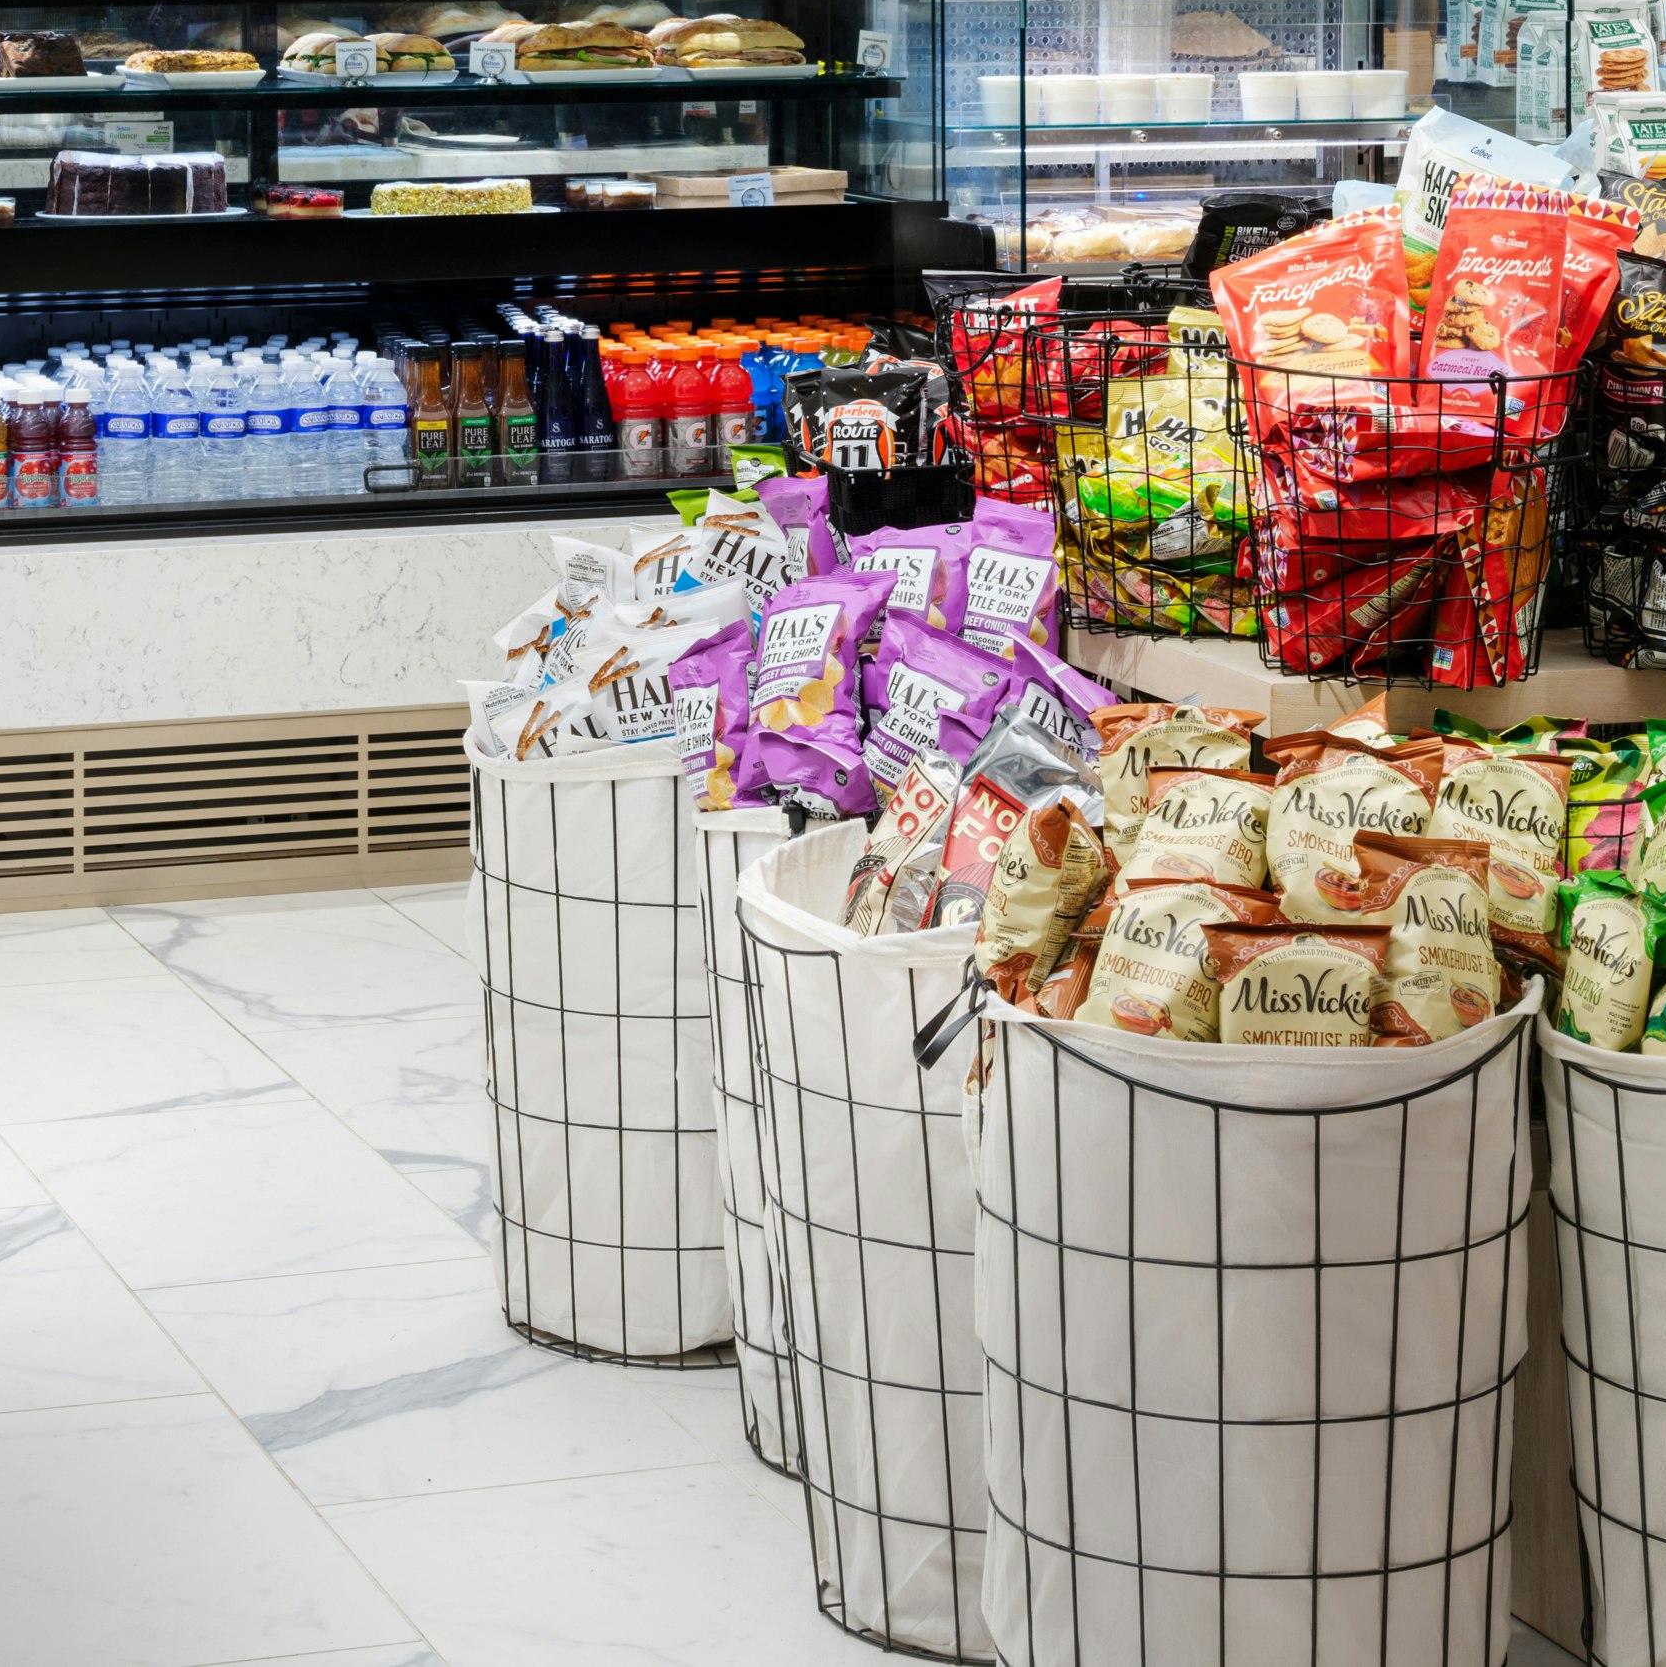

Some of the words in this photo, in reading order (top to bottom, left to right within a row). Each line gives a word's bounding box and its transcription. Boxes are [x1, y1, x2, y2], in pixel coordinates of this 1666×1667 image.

[1447, 248, 1552, 285] Fancypants
[1243, 262, 1374, 314] Fancypants
[421, 431, 445, 441] PURE
[465, 427, 488, 436] PURE
[833, 425, 878, 439] ROUTE
[837, 445, 869, 468] 11
[973, 557, 1039, 592] HAL'S
[970, 582, 995, 594] NEW
[998, 588, 1028, 601] YORK
[768, 613, 828, 641] HAL'S
[791, 645, 822, 659] CHIPS
[792, 637, 818, 647] YORK
[780, 664, 807, 678] ONION
[1282, 787, 1345, 829] Miss
[1140, 829, 1224, 849] SMOKEHOUSE
[1227, 840, 1253, 870] BBQ
[1419, 946, 1484, 973] SMOKEHOUSE
[1231, 974, 1297, 1015] Miss
